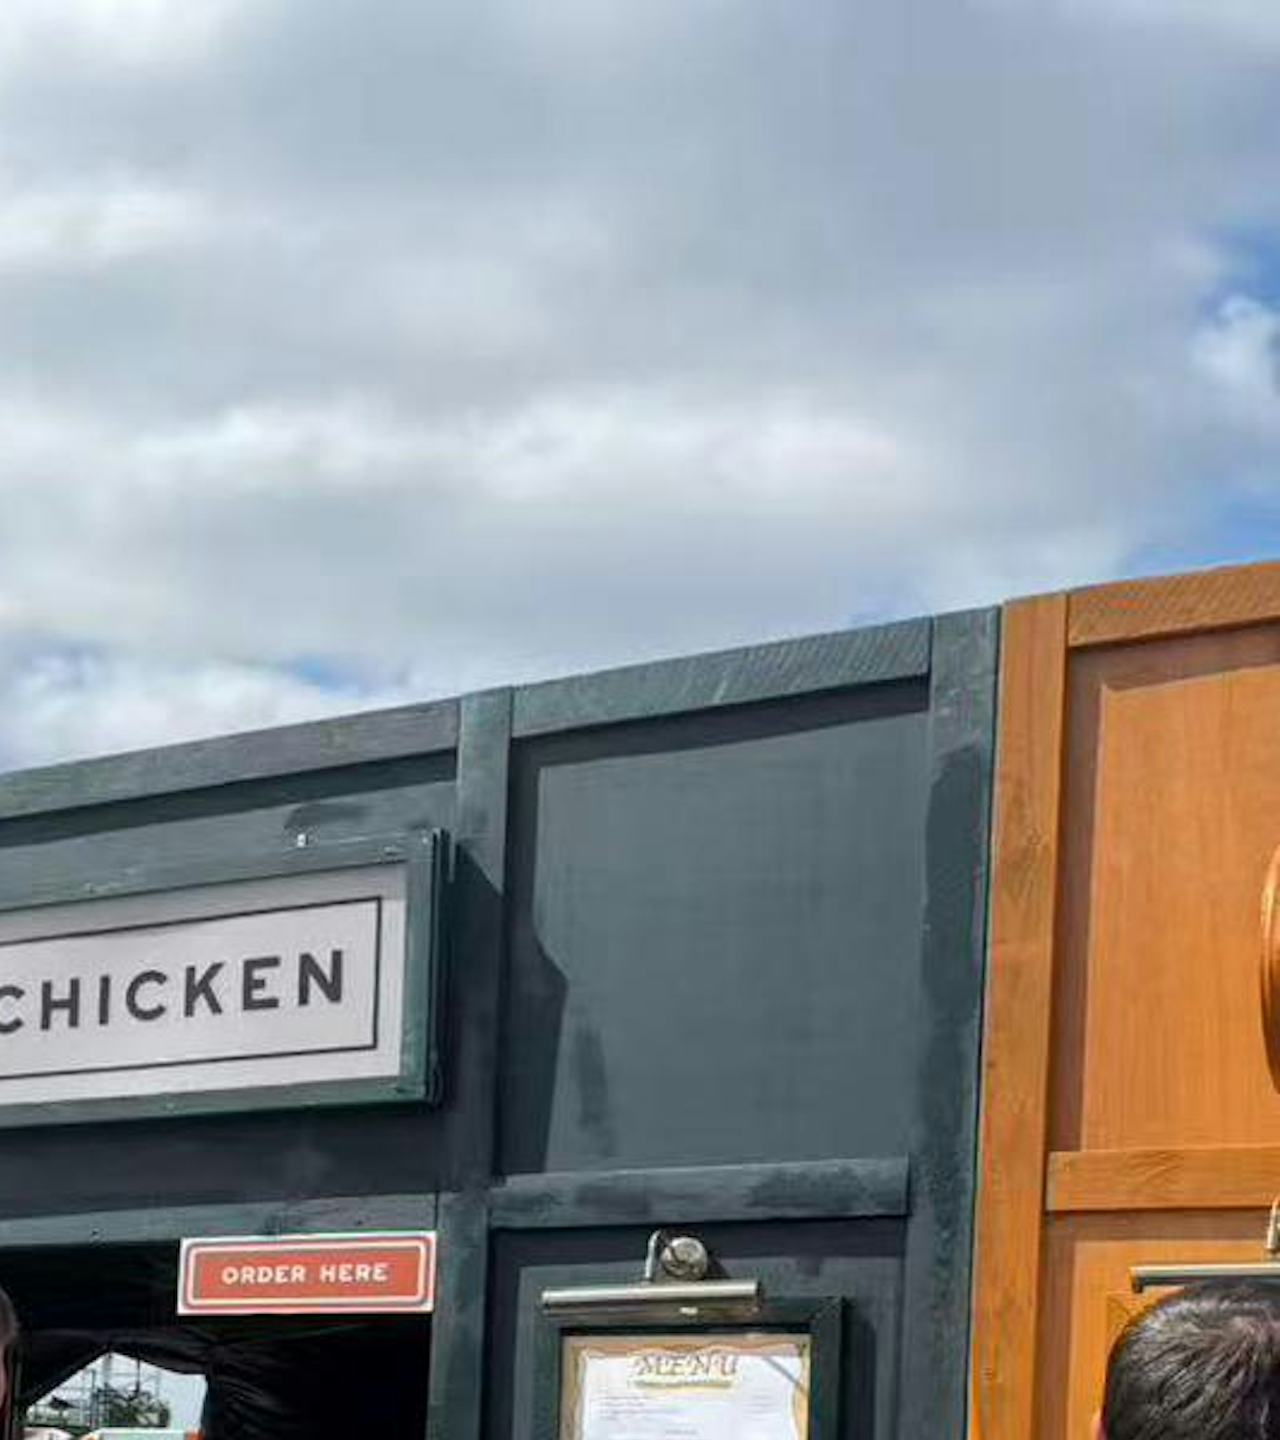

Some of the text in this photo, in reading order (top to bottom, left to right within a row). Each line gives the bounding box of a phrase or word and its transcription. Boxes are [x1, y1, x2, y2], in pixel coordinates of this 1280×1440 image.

[220, 1262, 389, 1285] ORDER HERE
[632, 1350, 739, 1377] MENU
